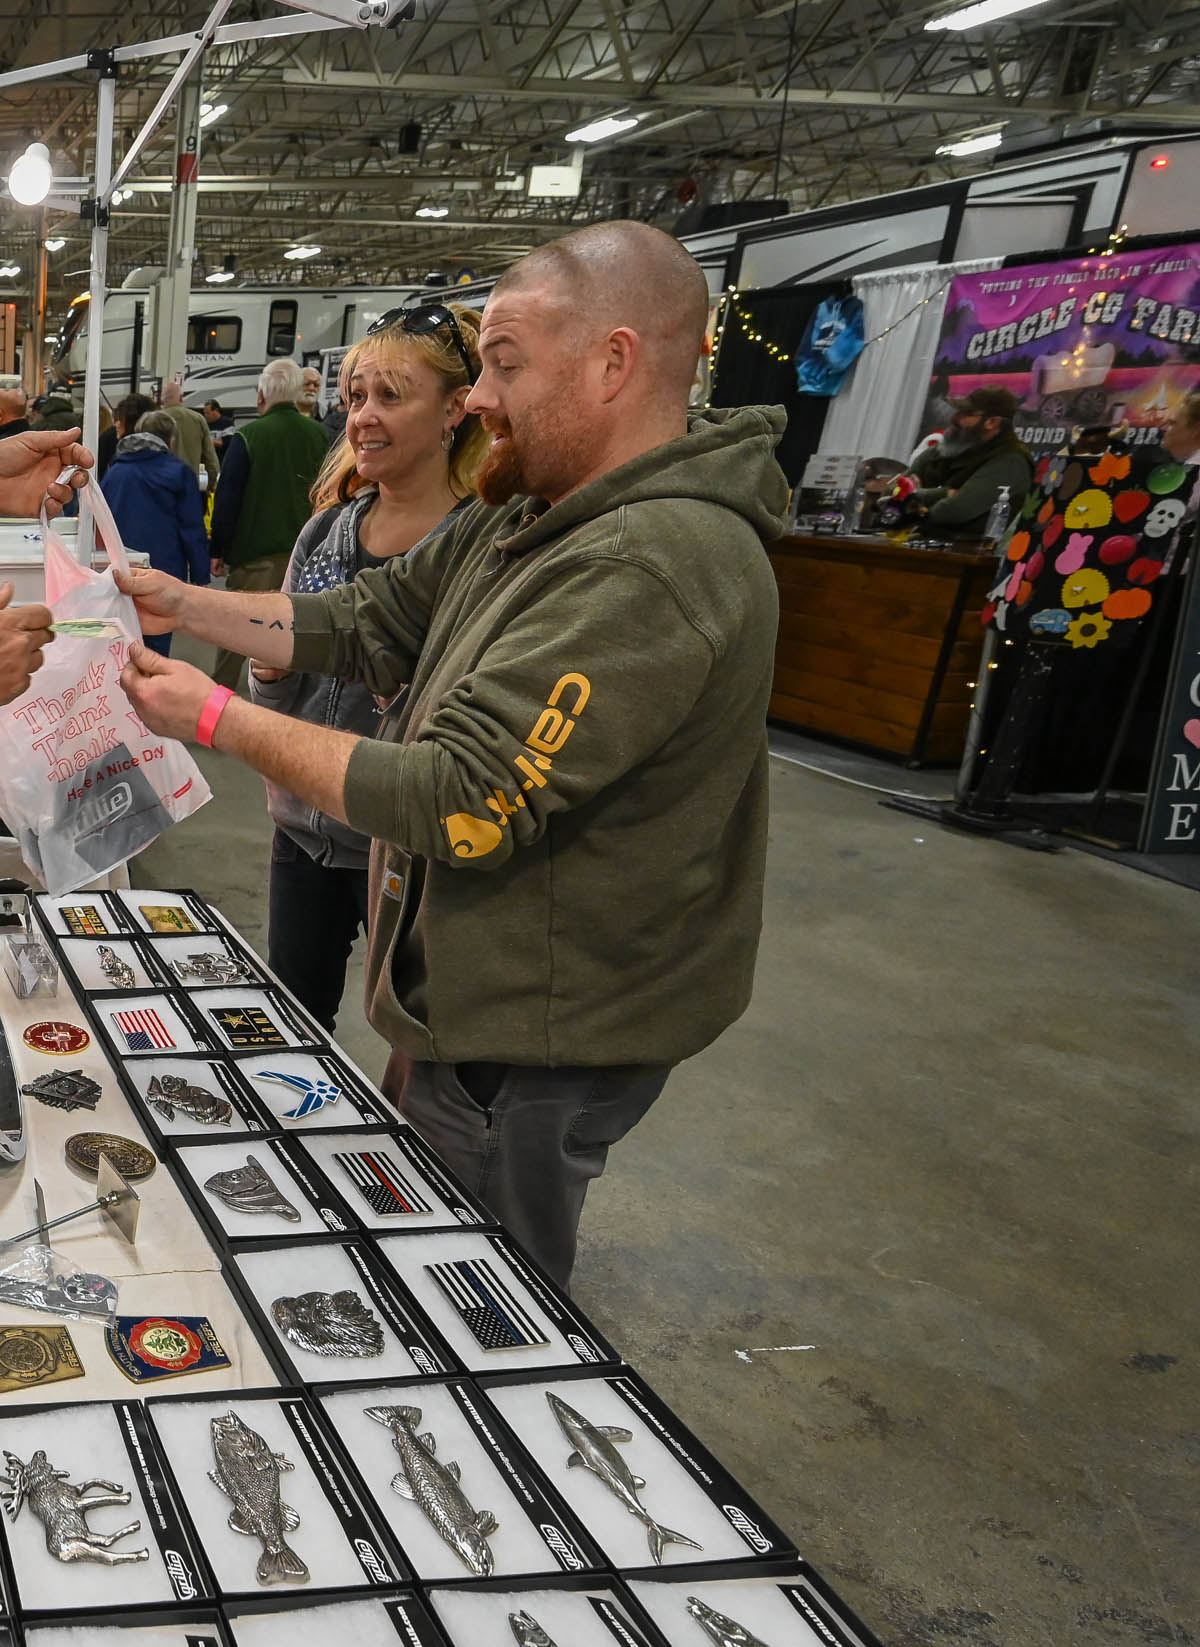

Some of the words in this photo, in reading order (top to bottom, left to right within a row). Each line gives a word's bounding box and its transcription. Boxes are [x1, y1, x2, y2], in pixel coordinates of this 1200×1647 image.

[966, 298, 1077, 360] CIRCLE
[1083, 292, 1126, 324] CG
[1130, 297, 1200, 344] FAR
[67, 776, 93, 802] Hae
[106, 756, 140, 778] Nice
[119, 1352, 142, 1376] SOUTH
[456, 1385, 497, 1446] www.GRILLIE.com
[615, 1381, 665, 1432] www.GRILLIE.com
[122, 1405, 147, 1468] www.GRILLIE.com
[290, 1405, 322, 1463] www.GRILLIE.com
[668, 1436, 690, 1459] designs
[323, 1468, 337, 1491] designs
[498, 1452, 515, 1475] designs
[540, 1524, 585, 1571] grillie
[723, 1505, 774, 1553] grillie
[165, 1550, 198, 1600] grillie
[355, 1539, 393, 1583] grillie
